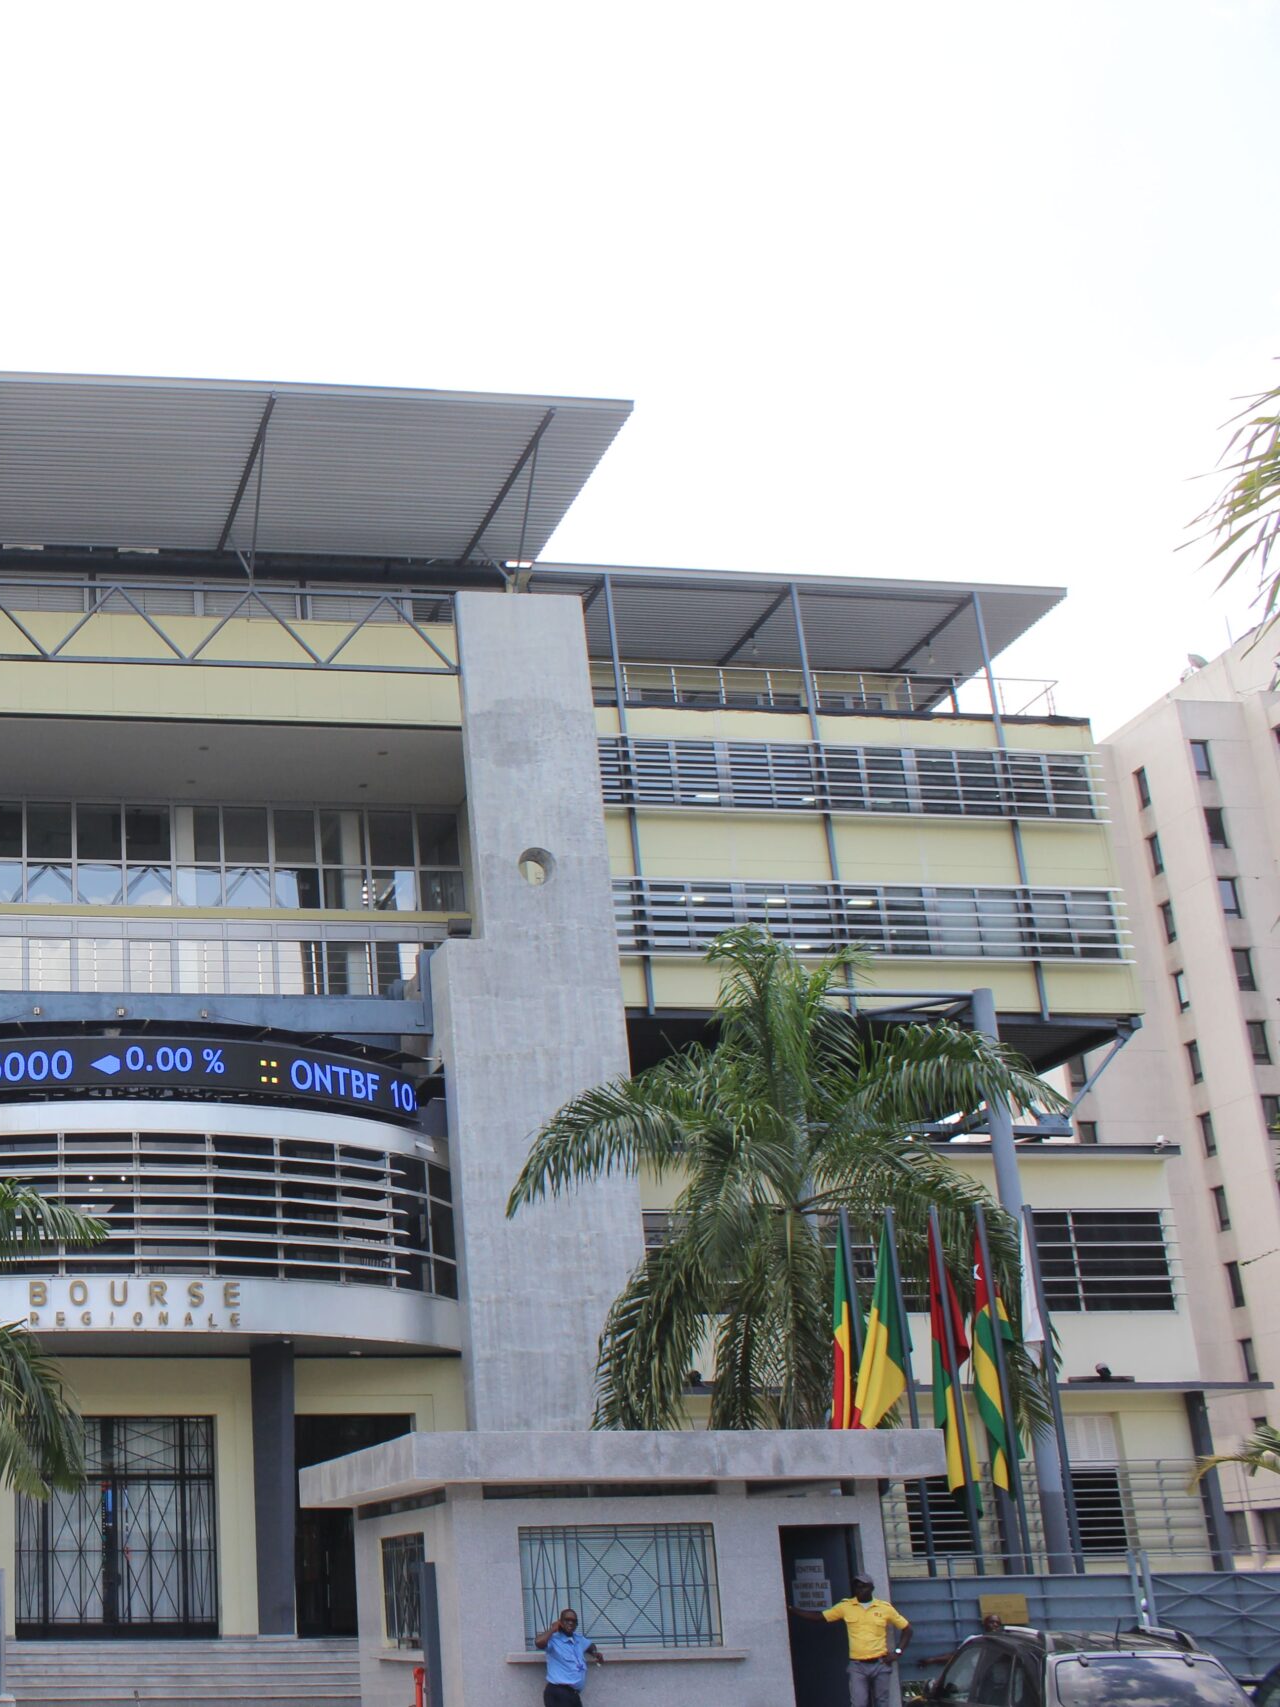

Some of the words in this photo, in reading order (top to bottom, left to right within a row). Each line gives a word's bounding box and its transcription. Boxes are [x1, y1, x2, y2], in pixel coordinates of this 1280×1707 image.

[125, 1046, 193, 1072] 0.00
[202, 1049, 225, 1073] %
[291, 1059, 380, 1101] ONTBF
[29, 1280, 241, 1308] BOURSE
[30, 1311, 241, 1327] REGIONALE
